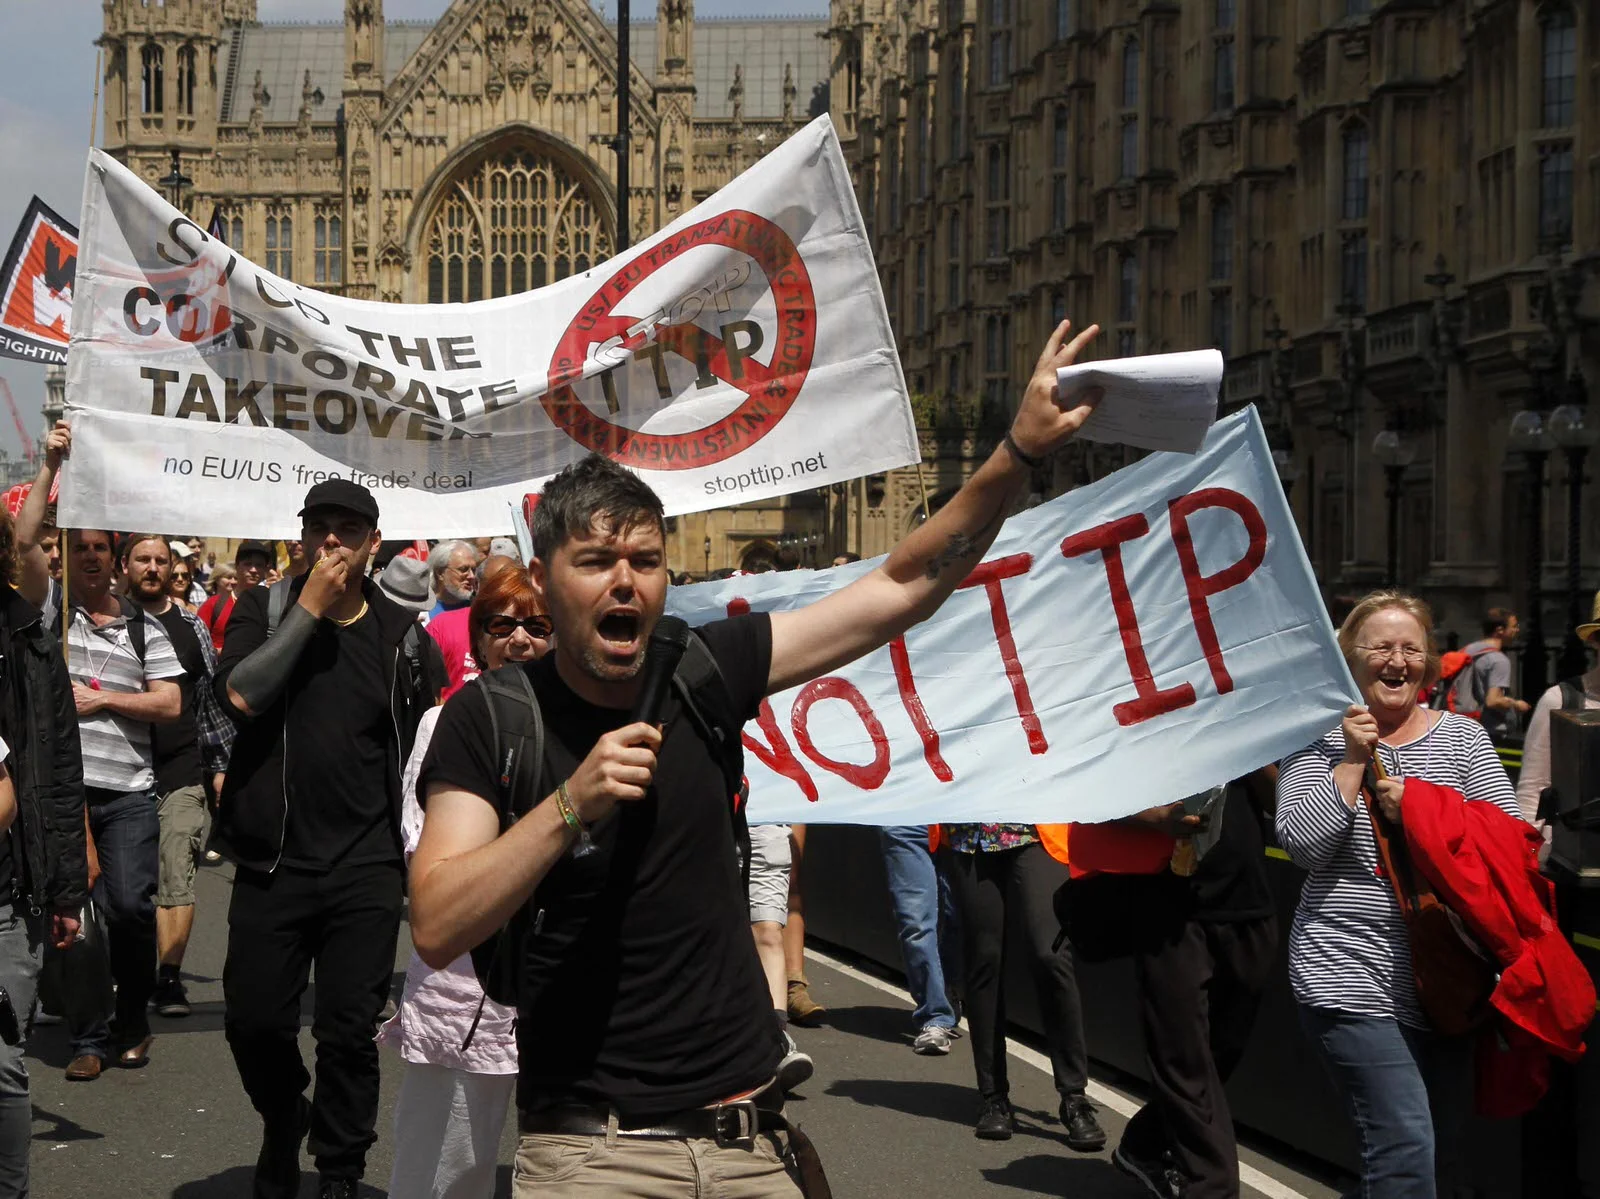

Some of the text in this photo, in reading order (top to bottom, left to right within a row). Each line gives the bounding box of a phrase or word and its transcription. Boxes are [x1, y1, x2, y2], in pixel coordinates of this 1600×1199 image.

[612, 266, 642, 293] EU
[594, 262, 751, 367] STOP
[777, 290, 806, 376] TRADE
[0, 335, 67, 363] IGHTIN
[123, 287, 520, 423] CORPORATE
[345, 325, 482, 371] THE
[586, 320, 764, 413] TTIP
[616, 401, 773, 462] INVESTMENT
[163, 457, 193, 475] no
[201, 456, 282, 482] EU/US
[423, 470, 473, 489] deal
[704, 451, 828, 495] stopttip.net
